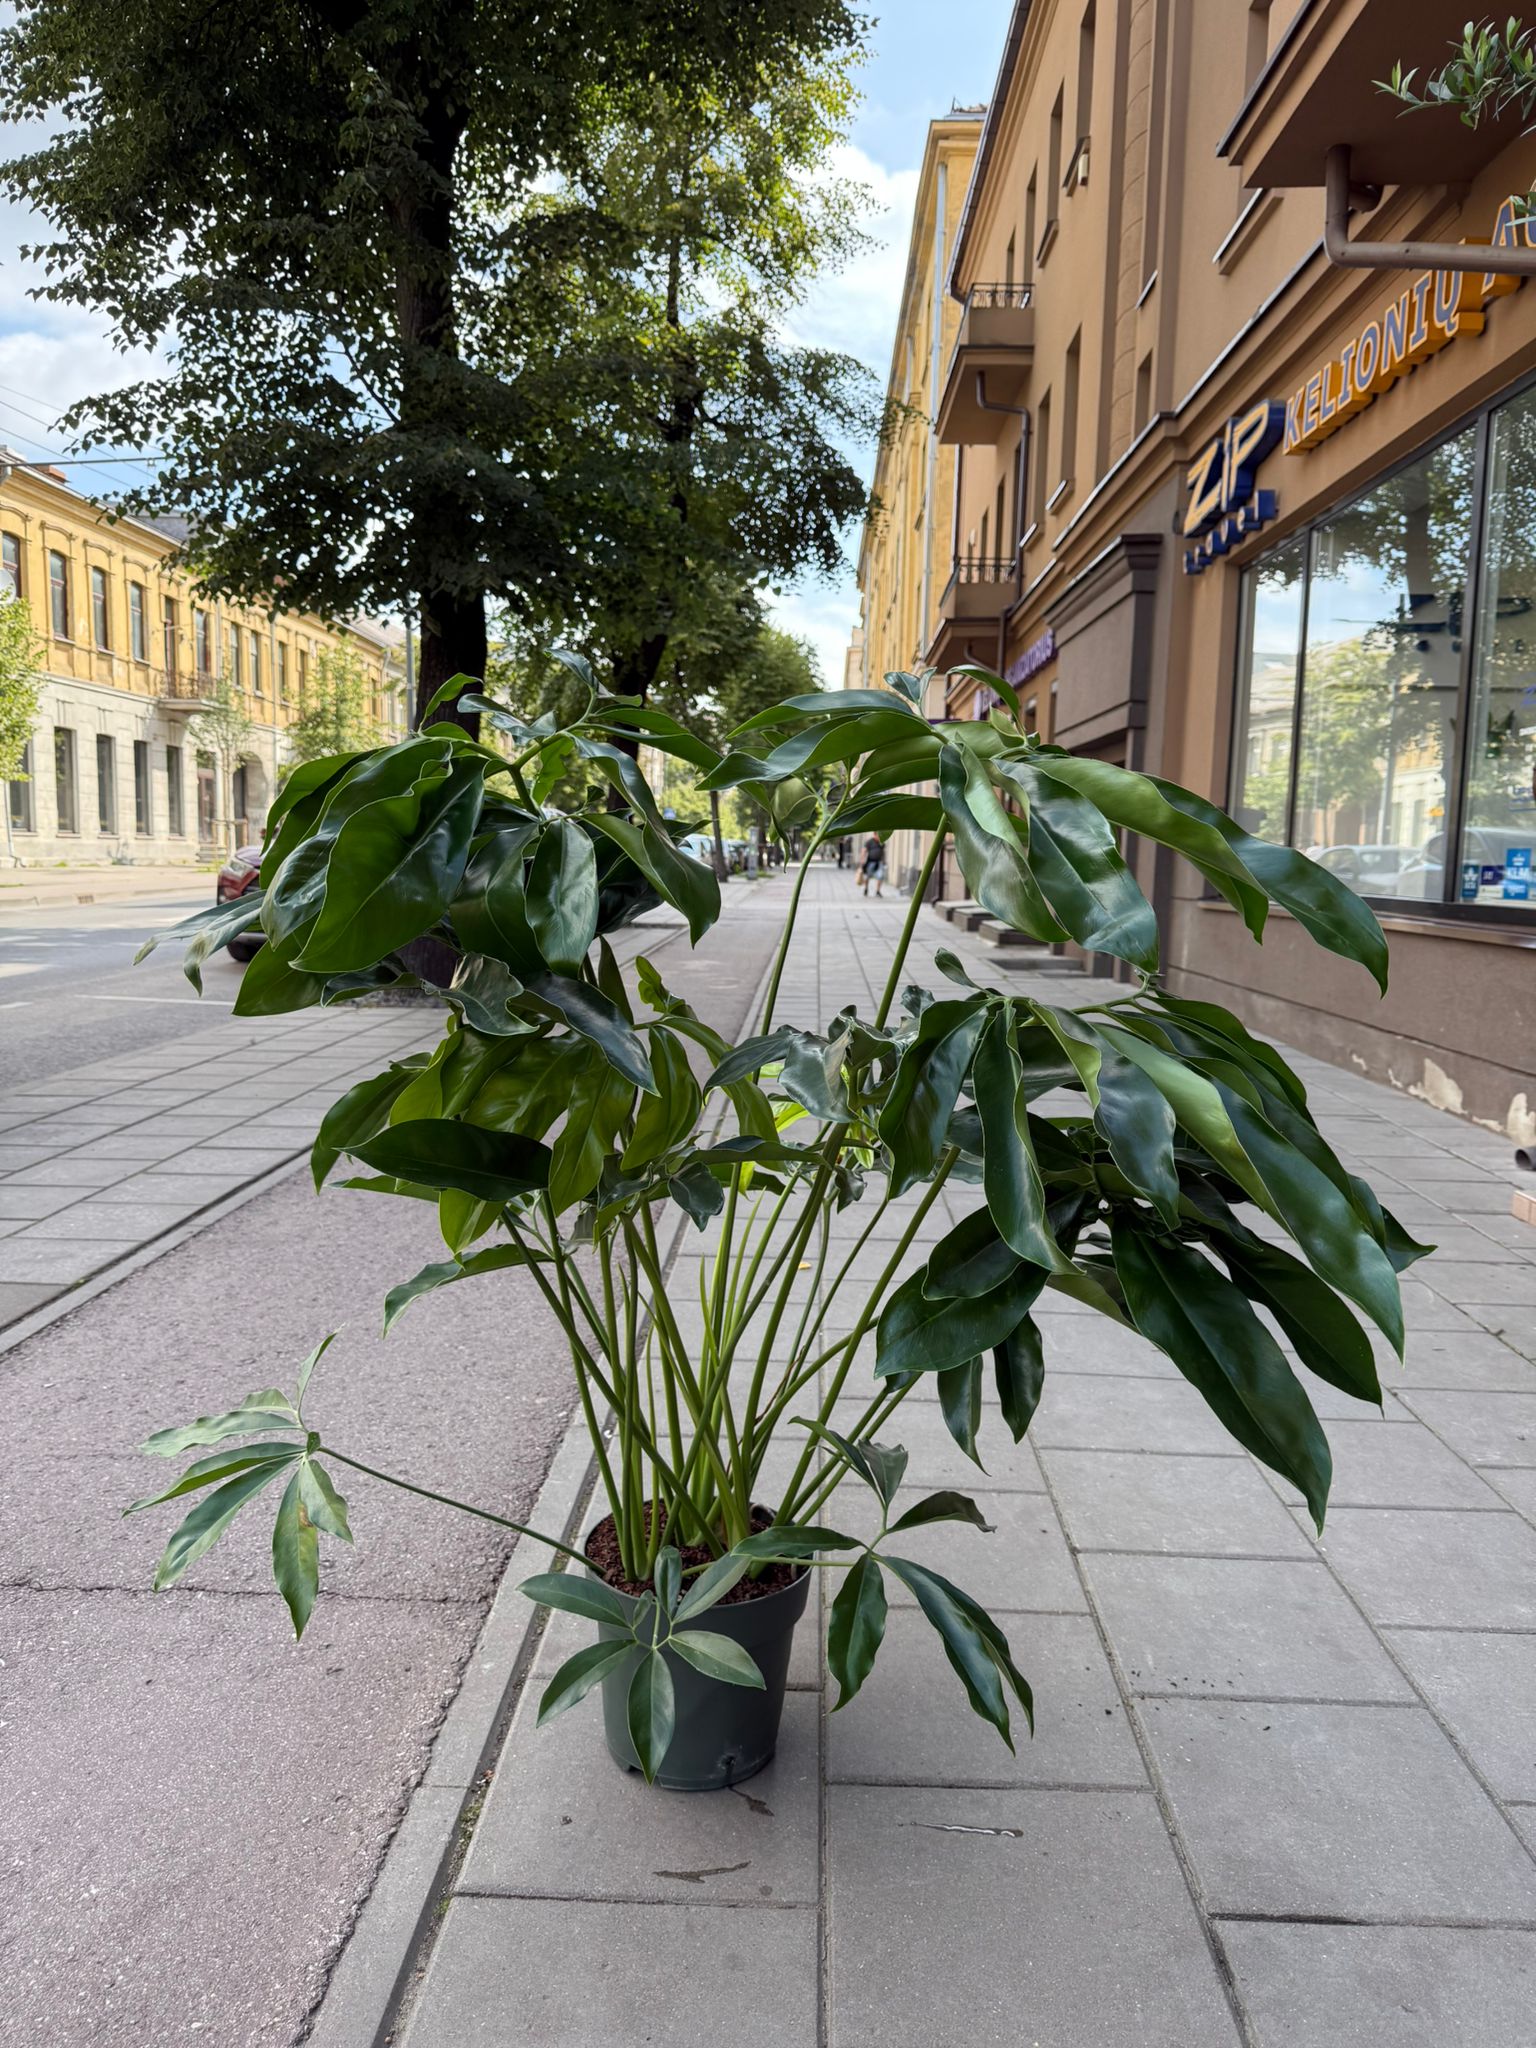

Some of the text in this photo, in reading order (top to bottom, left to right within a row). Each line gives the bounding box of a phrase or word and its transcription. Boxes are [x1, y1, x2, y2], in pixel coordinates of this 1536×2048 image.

[1282, 178, 1536, 454] KELIONIŲ A
[1184, 399, 1271, 538] ZIP
